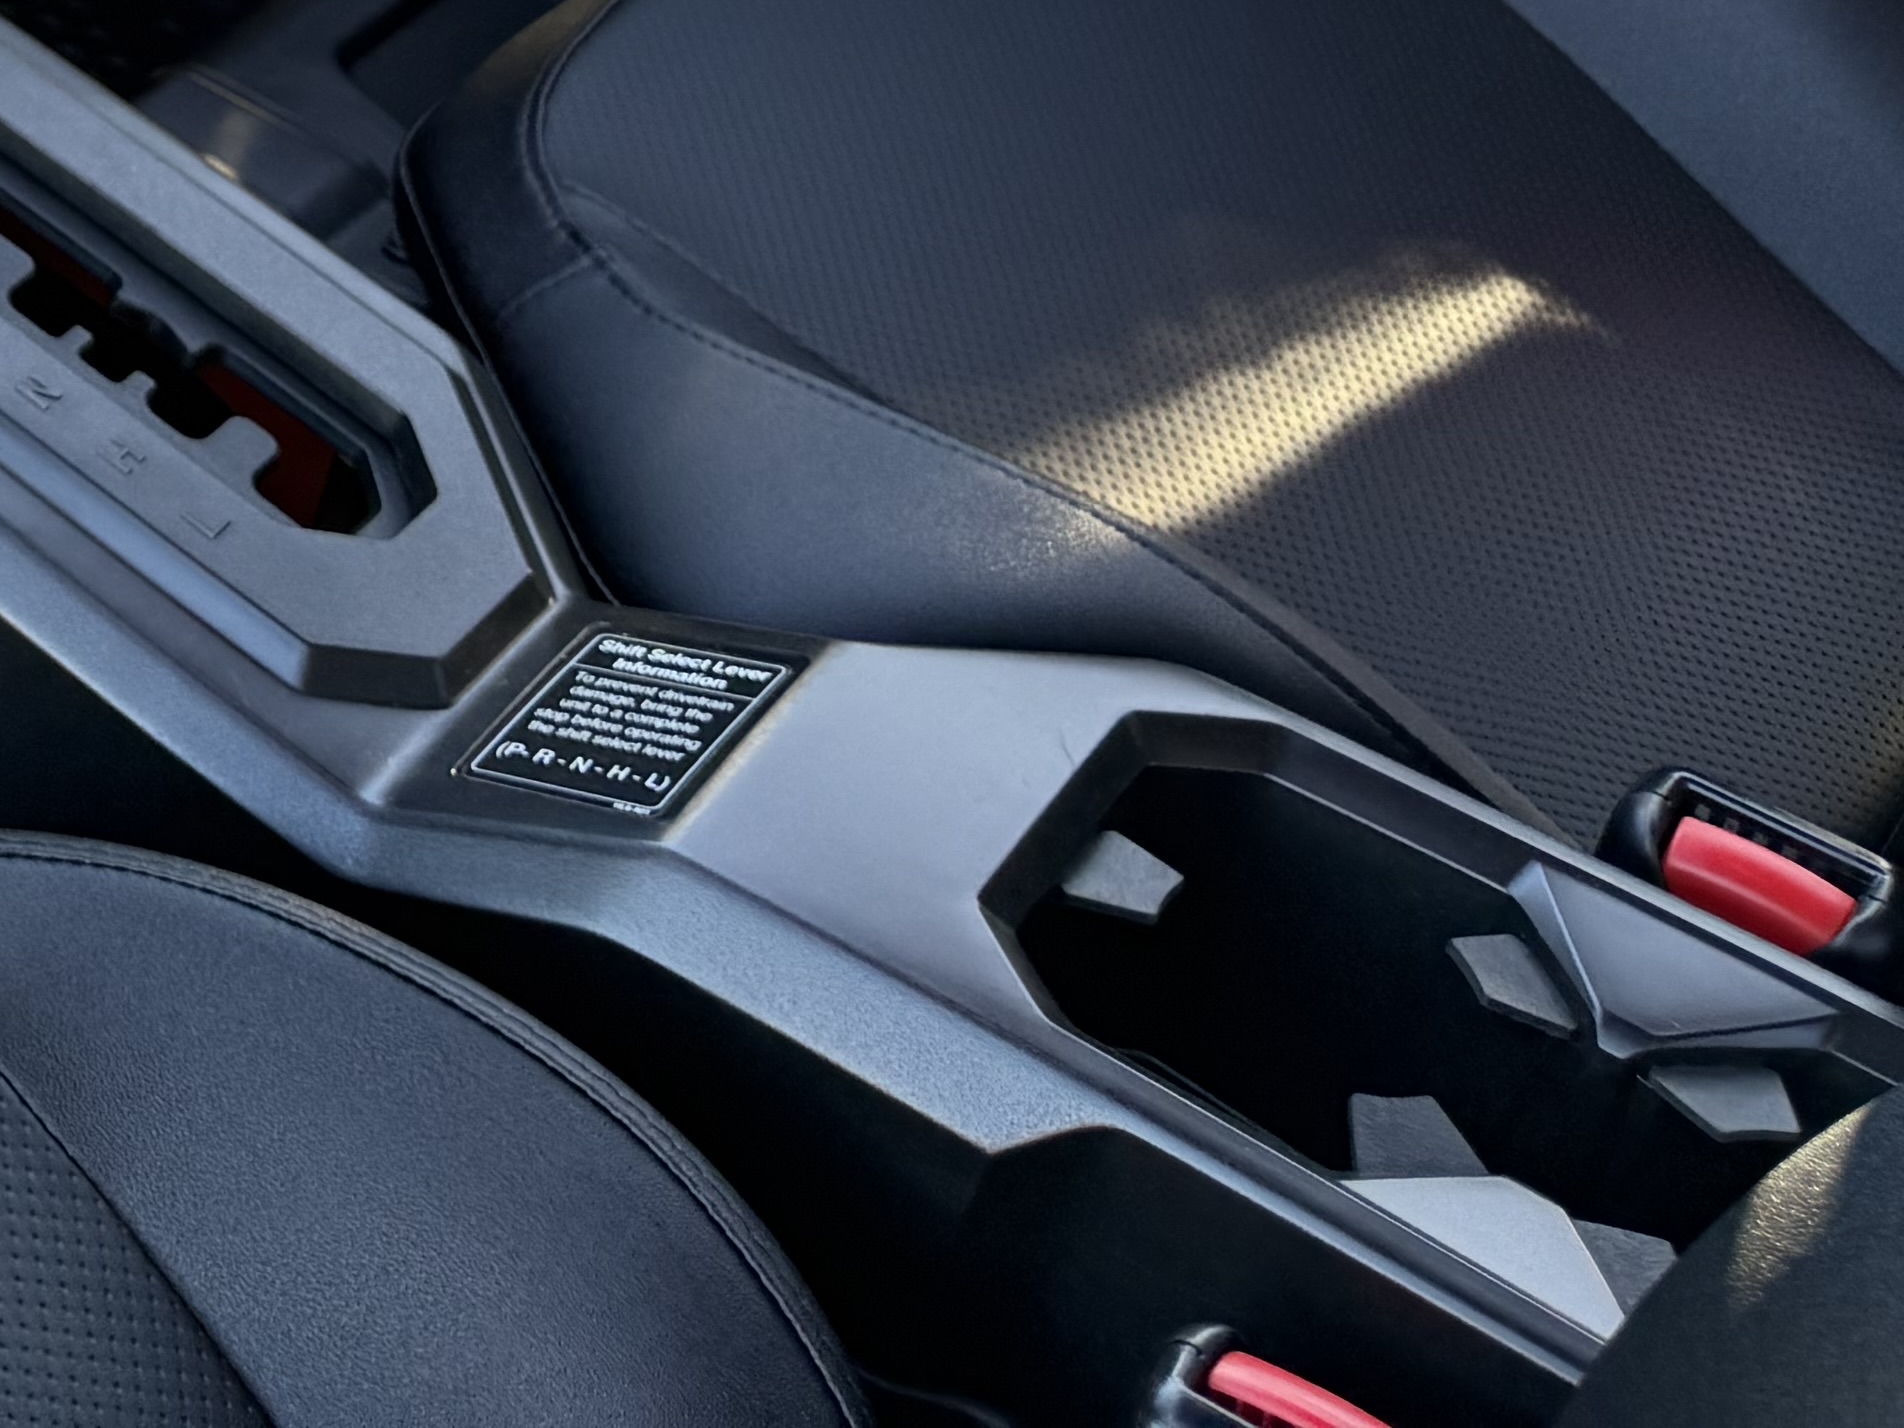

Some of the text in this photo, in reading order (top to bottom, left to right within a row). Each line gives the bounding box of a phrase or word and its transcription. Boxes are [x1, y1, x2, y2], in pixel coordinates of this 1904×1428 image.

[180, 510, 231, 540] L
[598, 639, 773, 682] Shift Select Lever
[612, 657, 728, 691] Information
[575, 670, 596, 684] To
[594, 677, 659, 697] prevent
[592, 704, 609, 716] to
[624, 712, 700, 734] complete
[640, 699, 684, 718] bring
[684, 708, 714, 723] the
[527, 719, 686, 761] the shift select lever
[533, 708, 702, 752] stop before operating
[532, 747, 556, 766] R
[569, 756, 594, 774] N
[606, 764, 632, 781] H
